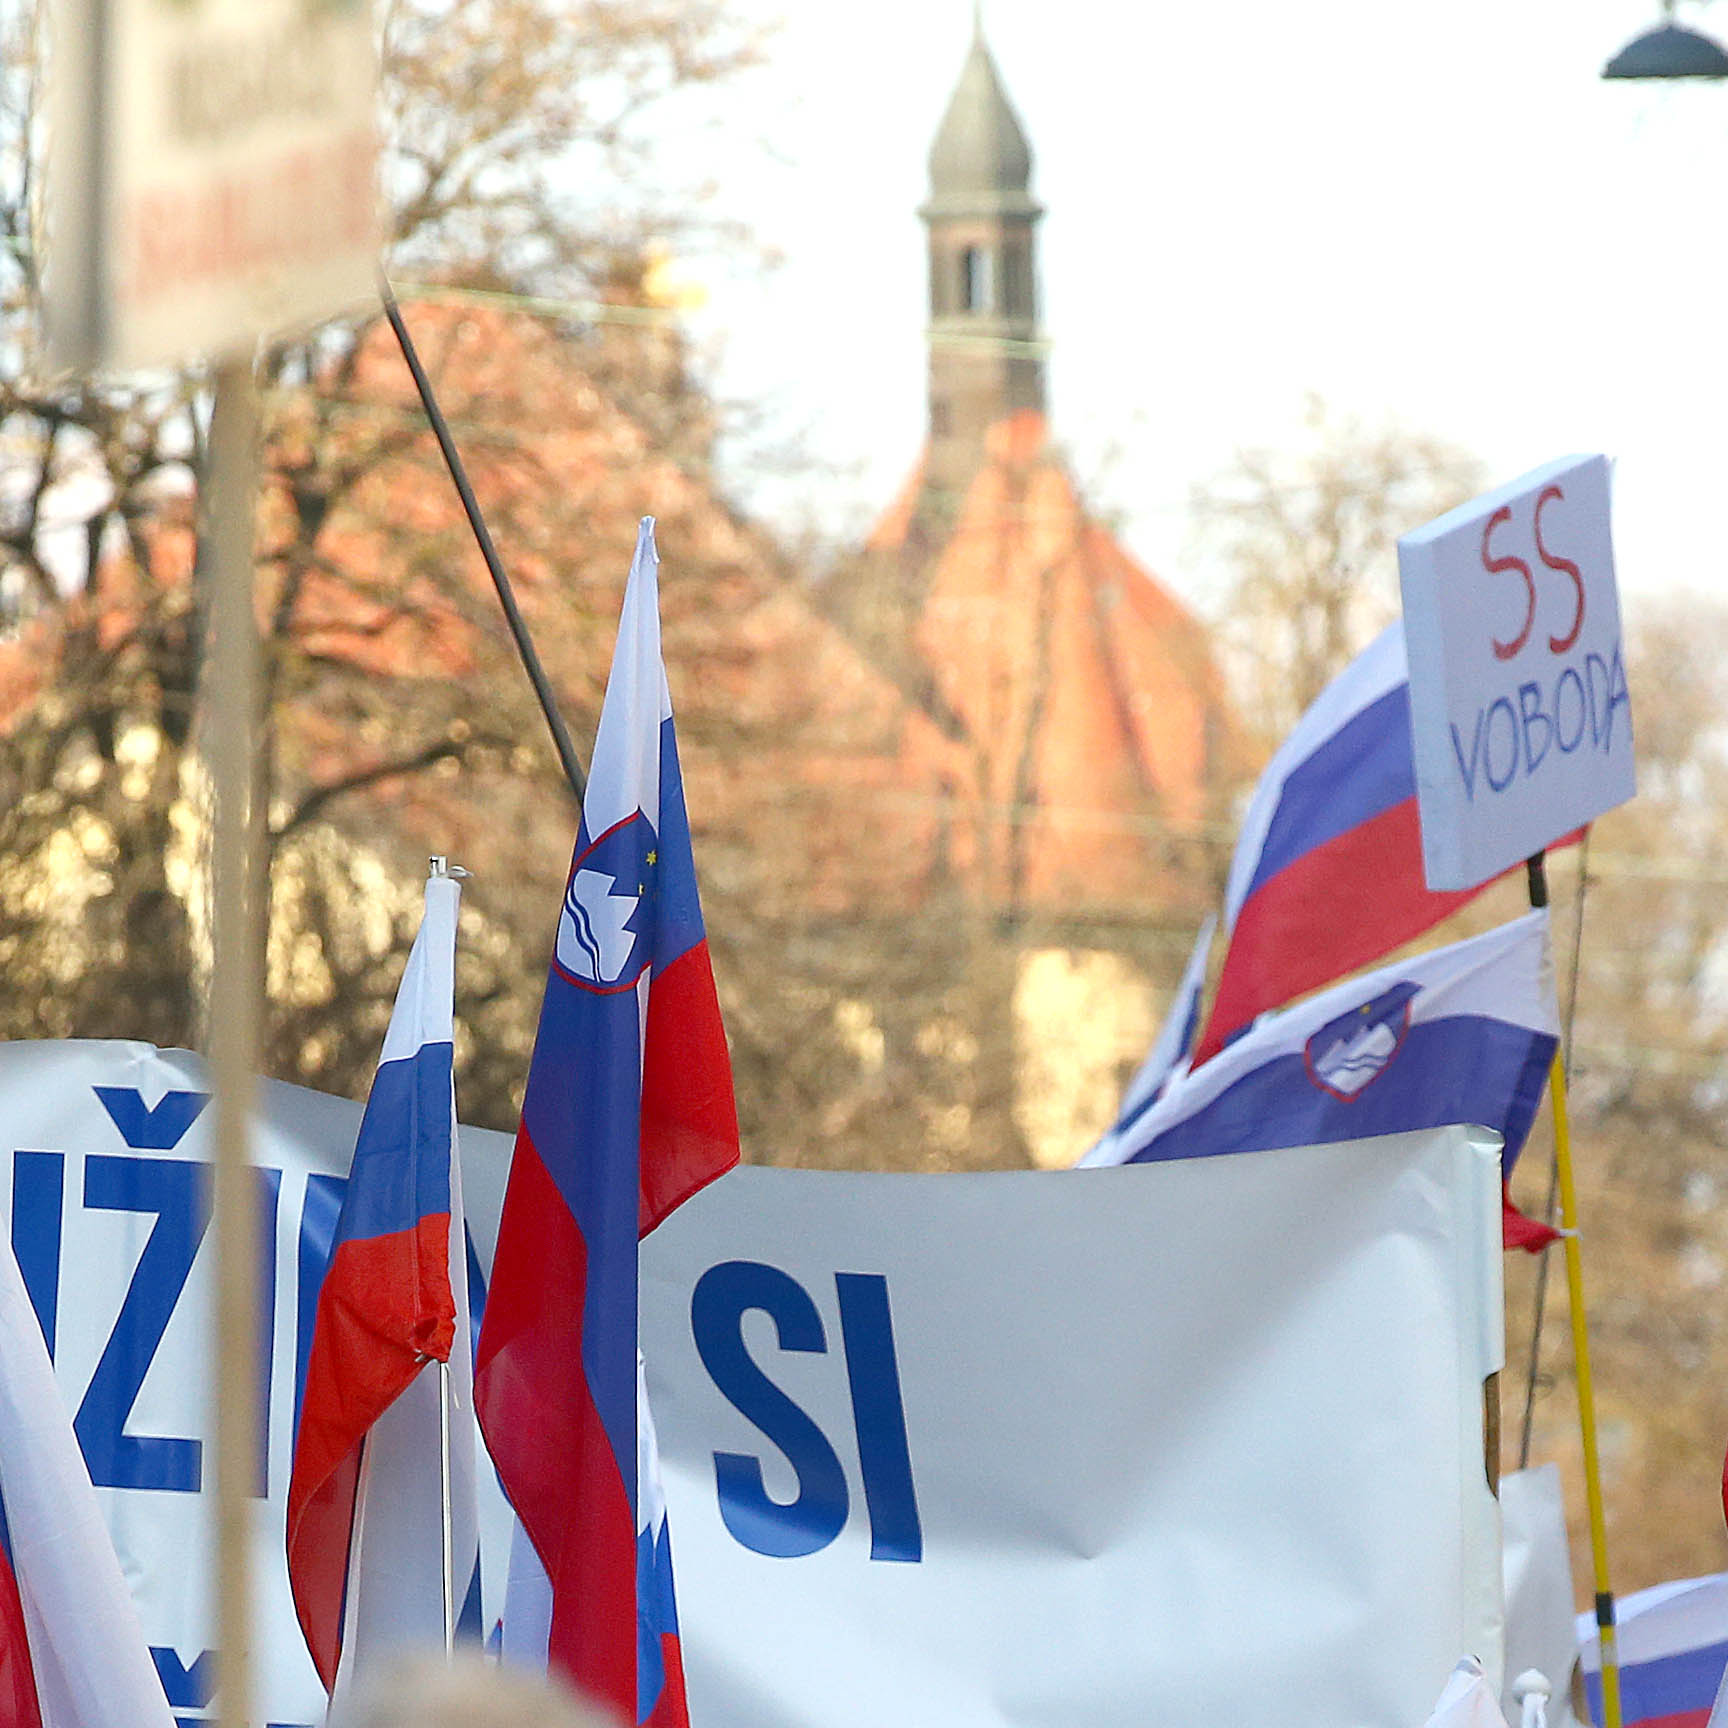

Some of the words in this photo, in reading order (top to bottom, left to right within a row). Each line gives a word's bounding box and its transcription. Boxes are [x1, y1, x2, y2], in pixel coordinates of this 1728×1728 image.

[1481, 484, 1586, 660] SS
[1450, 637, 1630, 803] VOBODA
[691, 1261, 923, 1564] SI
